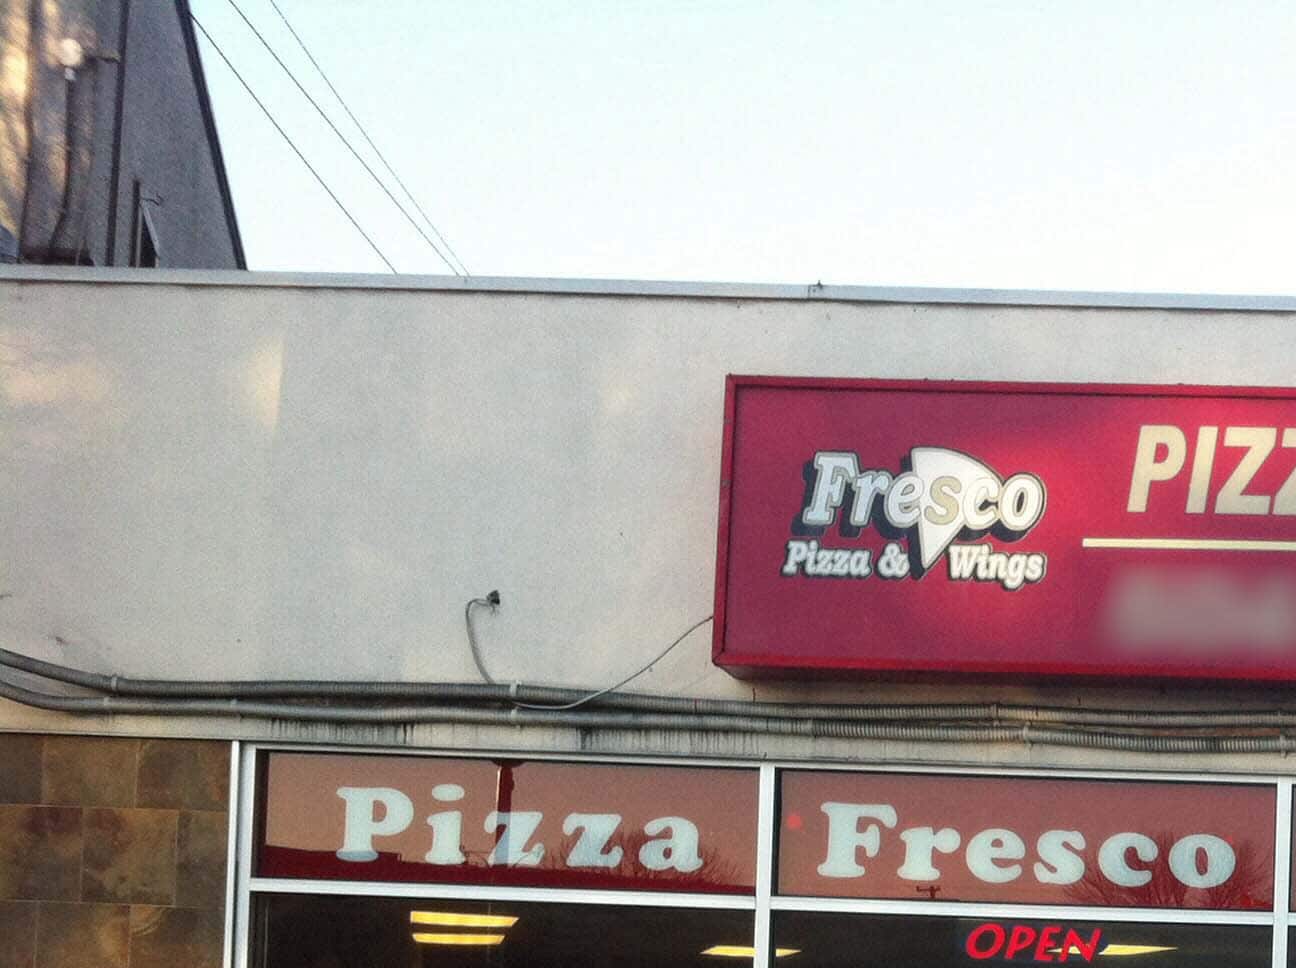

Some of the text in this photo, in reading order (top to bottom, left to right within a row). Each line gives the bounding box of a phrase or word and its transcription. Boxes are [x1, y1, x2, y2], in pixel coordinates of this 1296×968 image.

[799, 450, 1047, 533] Fresco
[781, 539, 1047, 591] Pizza & Wings
[335, 783, 704, 873] Pizza
[816, 801, 1237, 889] Fresco
[965, 921, 1103, 963] OPEN
